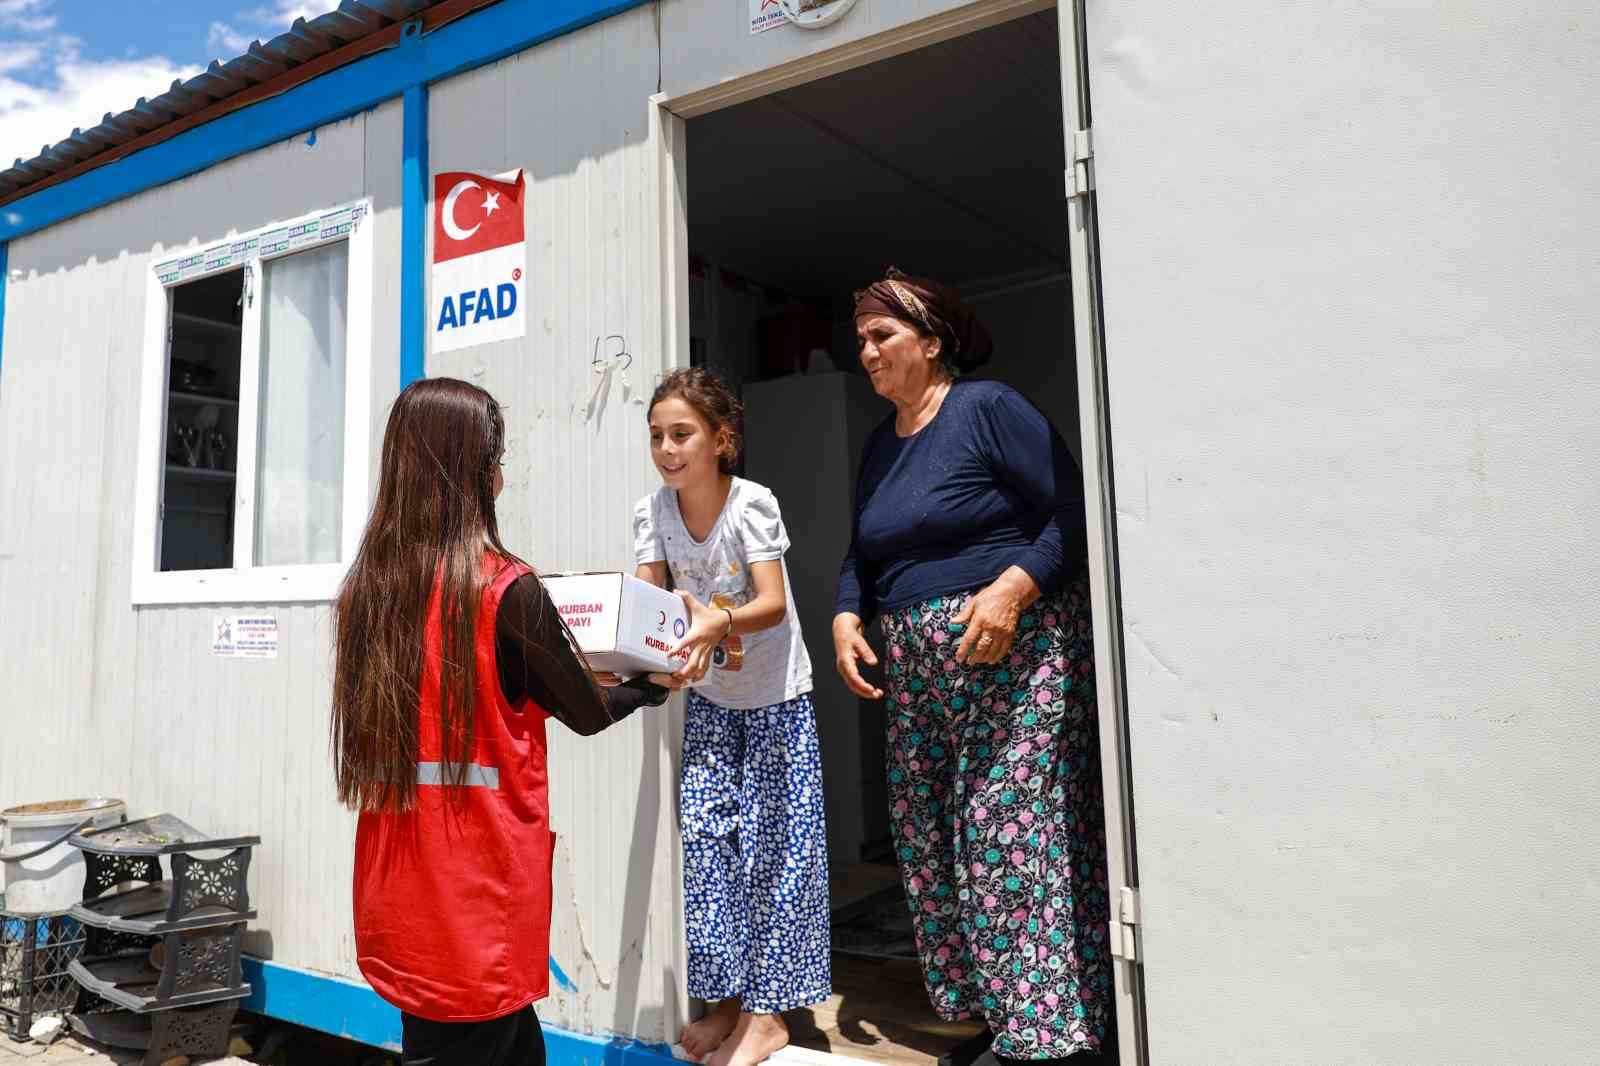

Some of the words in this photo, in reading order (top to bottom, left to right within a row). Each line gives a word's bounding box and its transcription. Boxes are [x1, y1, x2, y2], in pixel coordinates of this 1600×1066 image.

[437, 283, 517, 331] AFAD
[558, 603, 603, 614] KURBAN
[567, 617, 591, 627] PAYI
[645, 635, 673, 652] KURBA
